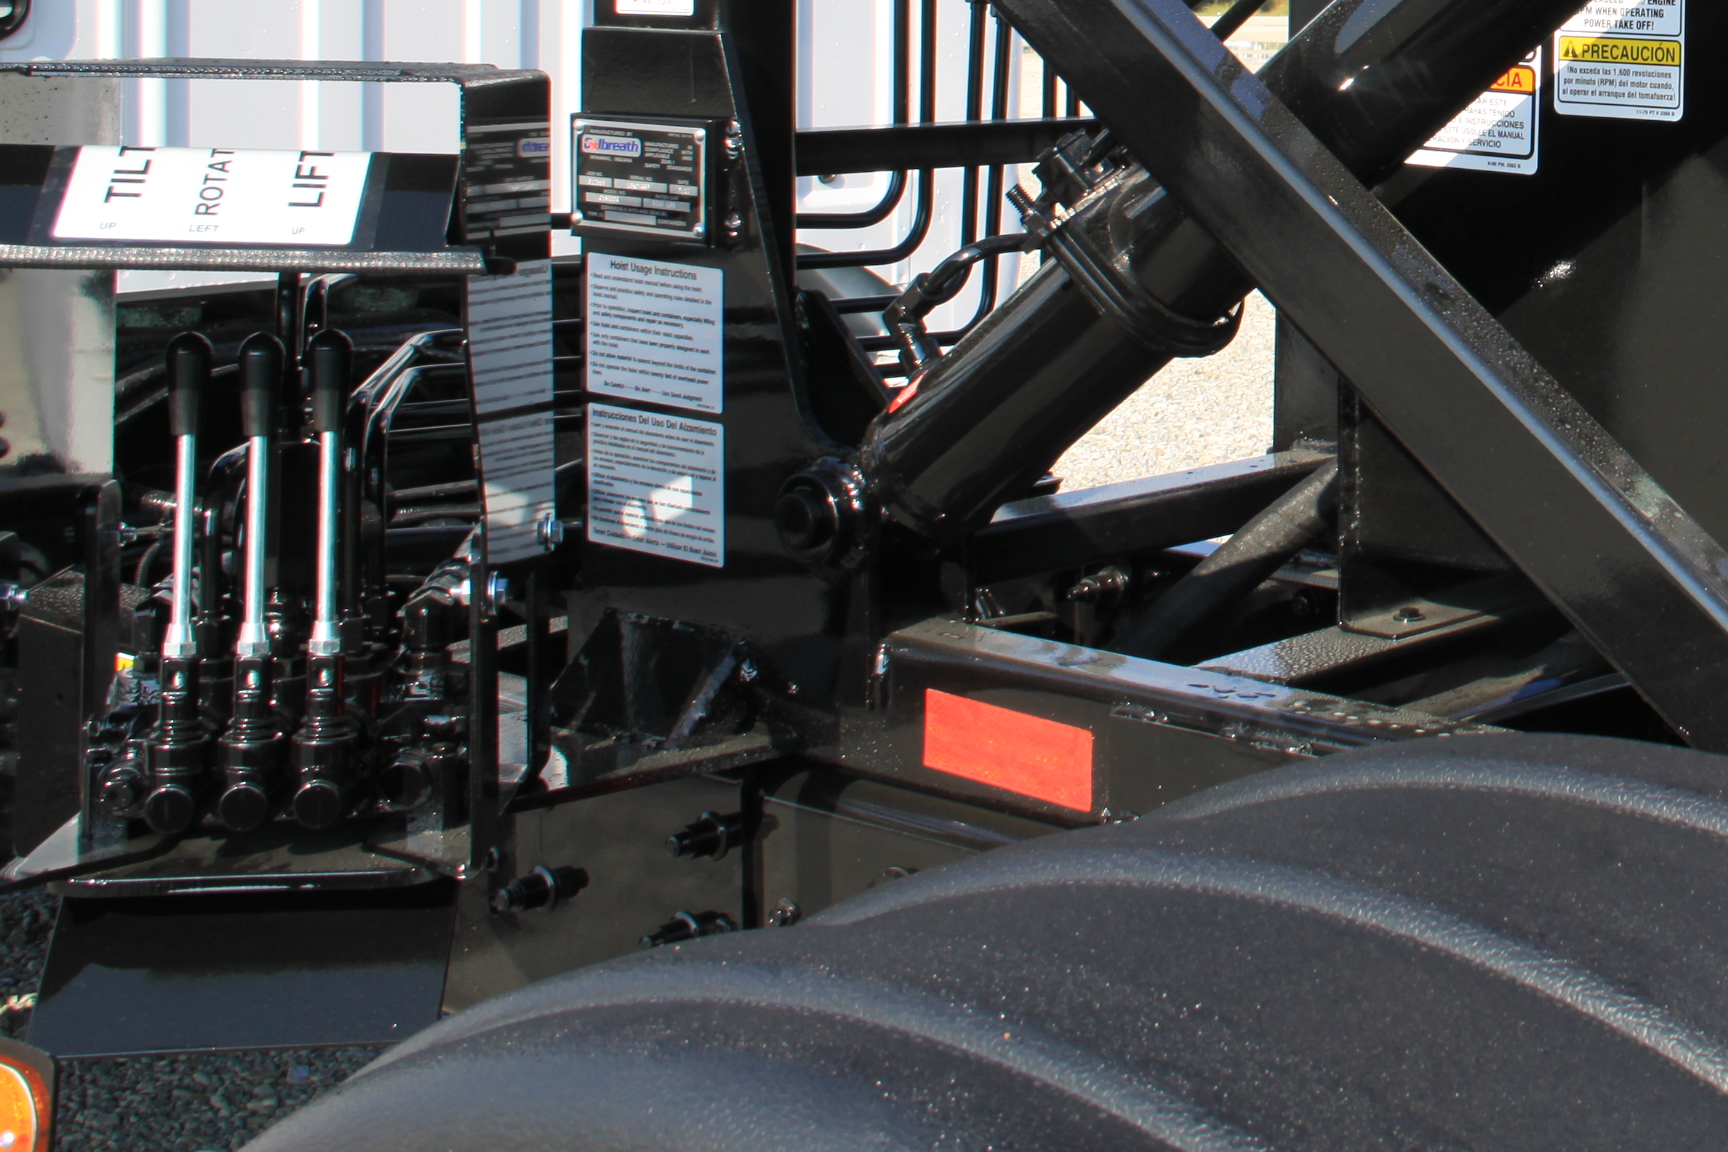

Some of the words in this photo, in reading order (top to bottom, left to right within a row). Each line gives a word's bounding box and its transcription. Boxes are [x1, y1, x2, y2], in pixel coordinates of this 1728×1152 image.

[1595, 6, 1617, 15] WHEN
[1619, 7, 1664, 18] OPERATING
[1584, 18, 1611, 28] POWER
[1614, 19, 1634, 29] TAKE
[1635, 21, 1654, 30] OFF!
[1582, 41, 1675, 62] PRECAUCIÓN
[1579, 66, 1600, 74] exceda
[1602, 67, 1610, 75] las
[1631, 69, 1671, 78] revoluciones
[1563, 77, 1574, 85] por
[1597, 78, 1616, 87] (RPM)
[1630, 80, 1647, 88] motor
[1598, 90, 1625, 98] arranque
[1490, 98, 1507, 106] ESTE
[1489, 109, 1515, 117] TENIDO
[1465, 117, 1524, 129] INSTRUCCIONES
[1497, 130, 1524, 139] MANUAL
[1468, 138, 1501, 148] SERVICIO
[194, 148, 236, 215] ROTAT
[288, 150, 335, 207] LIFT
[99, 222, 117, 230] UP
[188, 224, 219, 233] LEFT
[291, 227, 305, 235] UP
[610, 259, 628, 271] Hoist
[630, 262, 652, 276] Usage
[654, 265, 697, 280] Instructions
[592, 407, 636, 422] Instrucciones
[639, 415, 649, 425] Del
[651, 418, 664, 427] Uso
[666, 420, 676, 429] Del
[679, 422, 717, 436] Alzamiento
